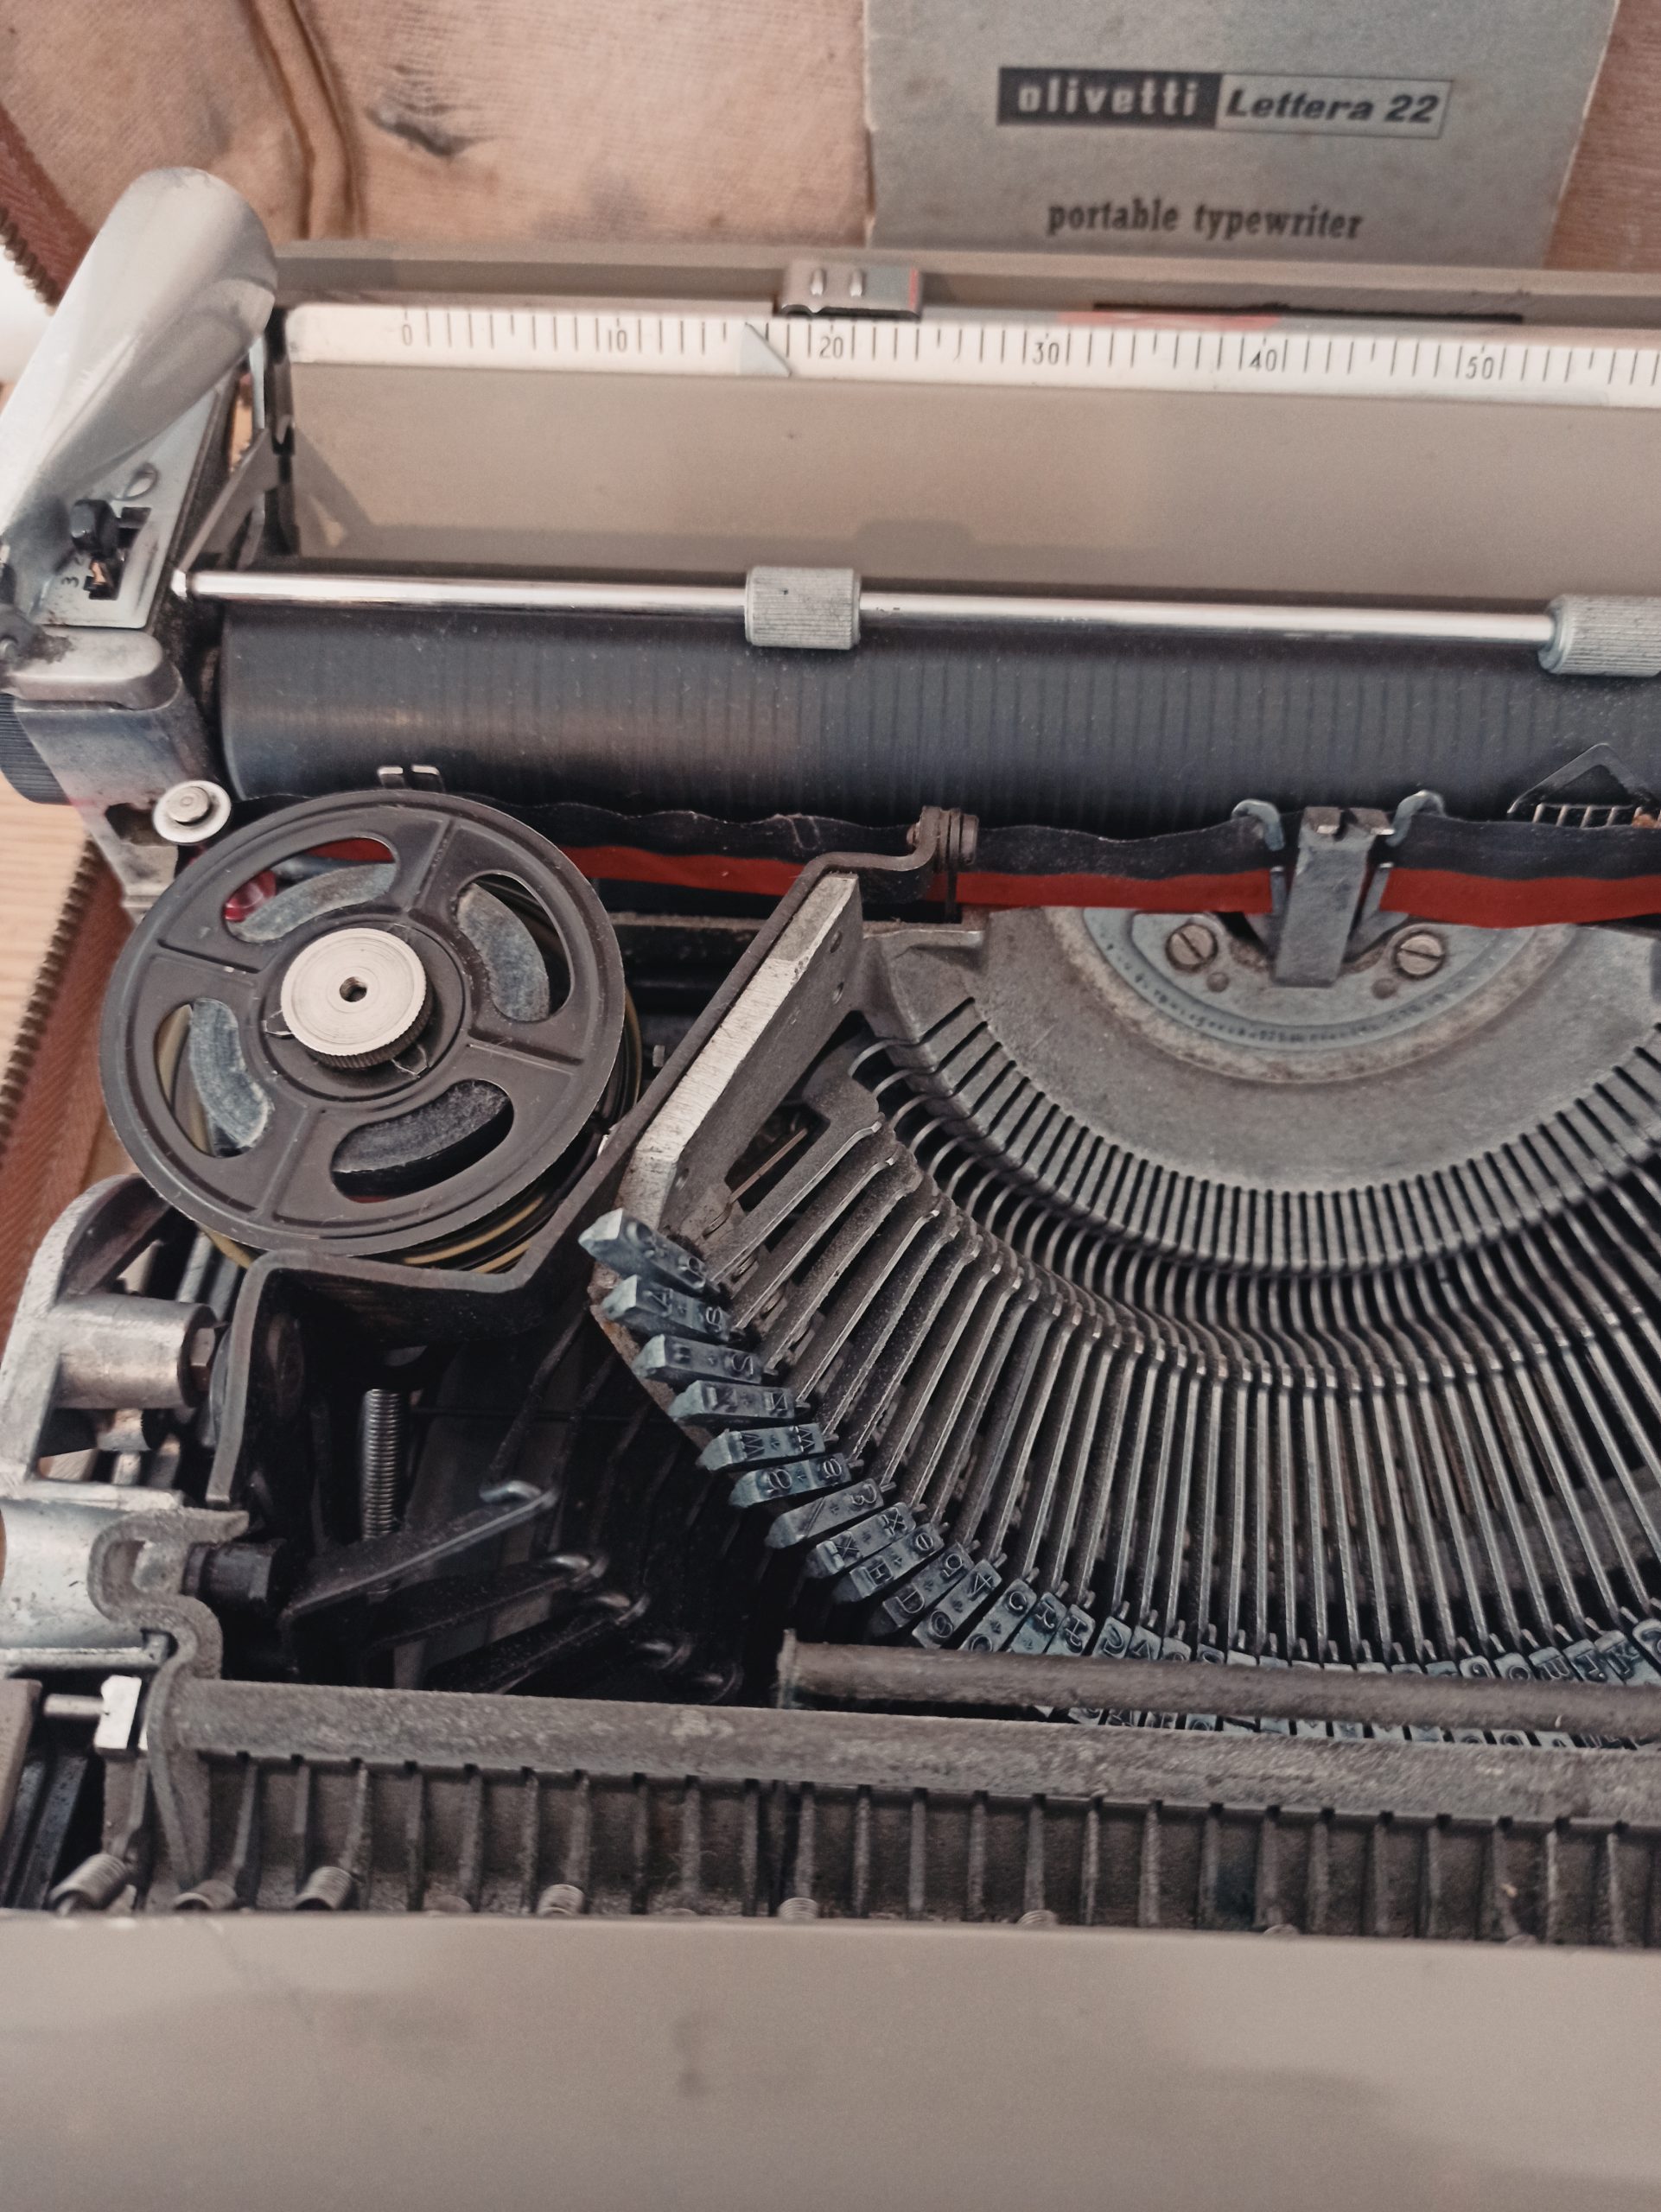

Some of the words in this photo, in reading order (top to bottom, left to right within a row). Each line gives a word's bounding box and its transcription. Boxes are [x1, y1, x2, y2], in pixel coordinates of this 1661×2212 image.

[1017, 74, 1199, 118] olivetti
[1225, 88, 1374, 123] Lettera
[1383, 94, 1441, 124] 22
[1046, 195, 1179, 237] portable
[1193, 202, 1365, 241] typewriter
[401, 322, 413, 346] 0
[607, 328, 628, 353] 10
[818, 336, 844, 359] 20
[1032, 341, 1060, 366] 30
[1248, 349, 1277, 372] 40
[1464, 355, 1495, 379] 50
